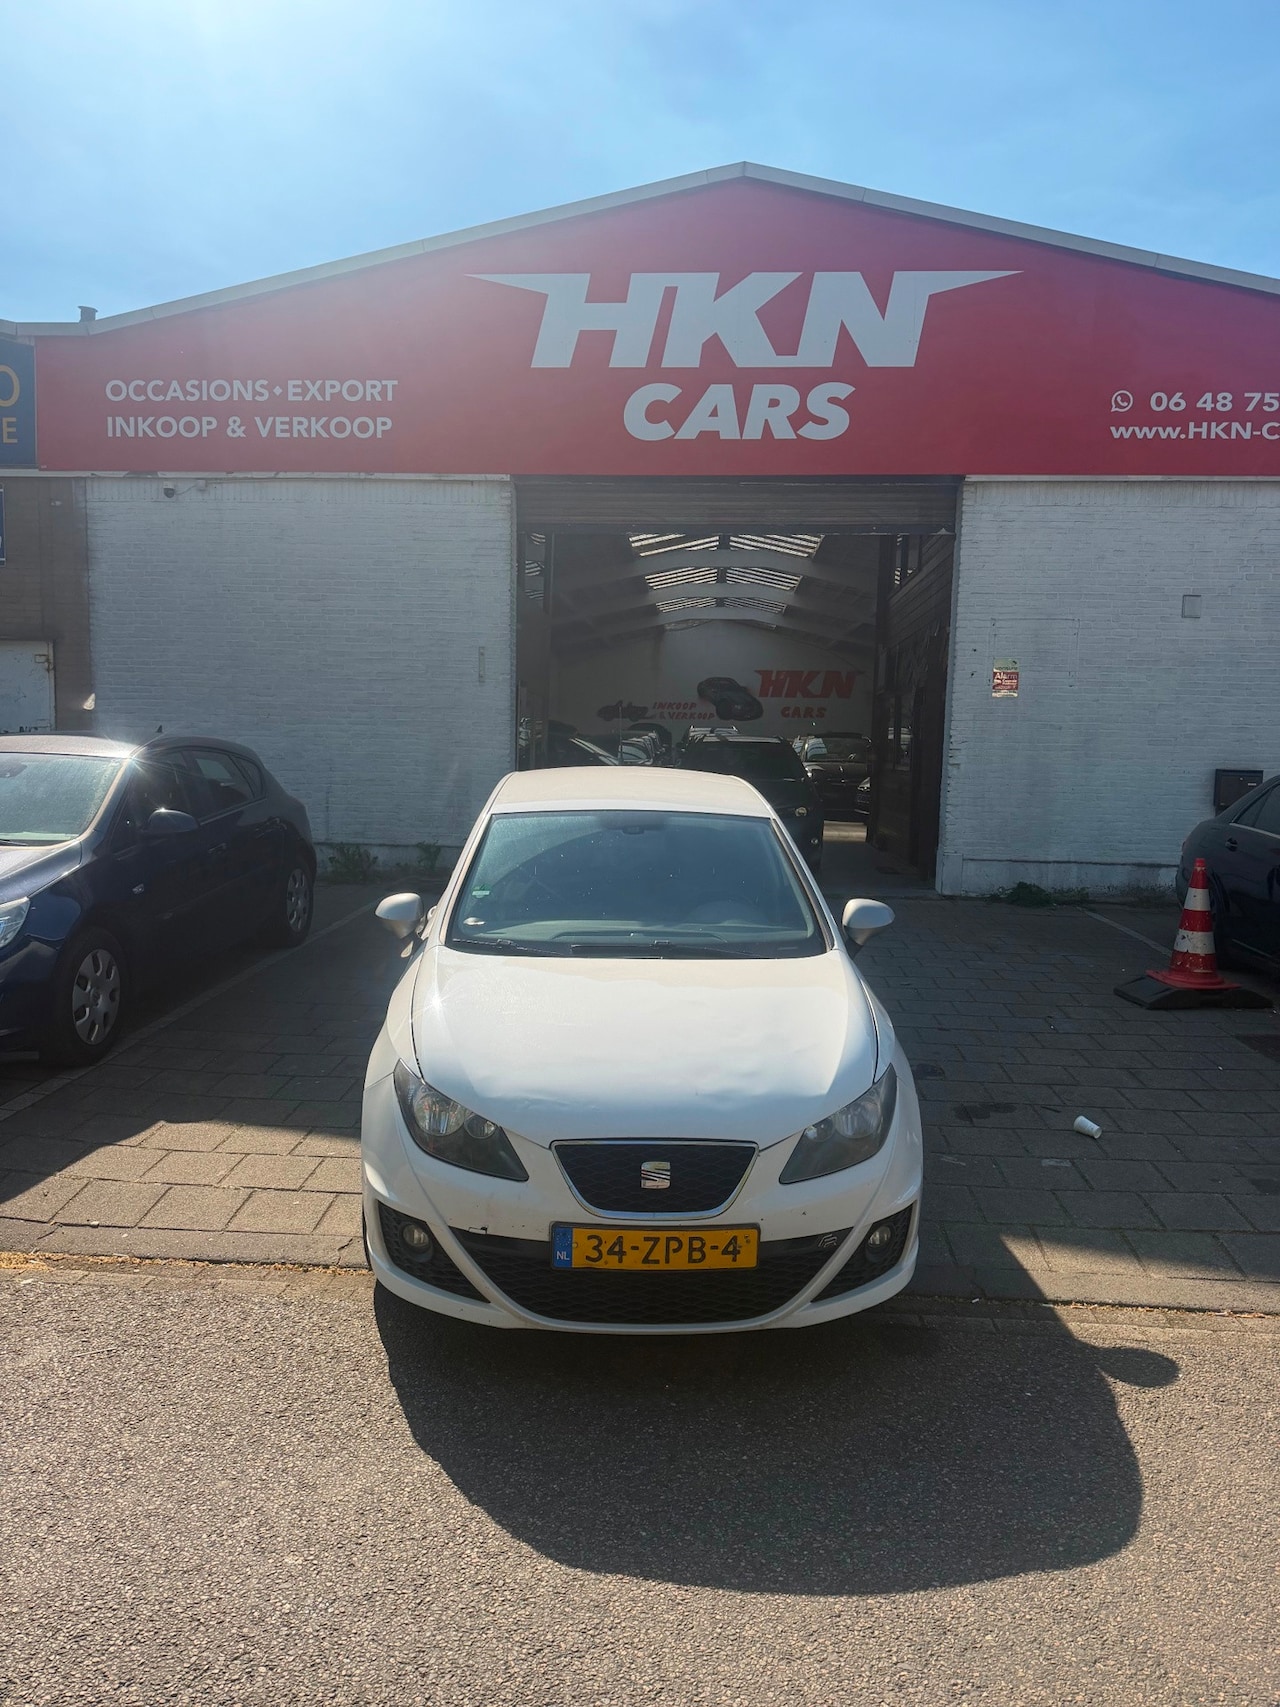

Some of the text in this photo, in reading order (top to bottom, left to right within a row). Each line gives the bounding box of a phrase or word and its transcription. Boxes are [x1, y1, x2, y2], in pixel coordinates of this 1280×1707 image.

[464, 270, 1024, 369] HKN
[105, 378, 399, 403] OCCASIONS EXPORT
[1149, 391, 1280, 412] 06 48 75
[623, 381, 857, 442] CARS
[106, 416, 393, 440] INKOOP & VERKOOP
[1110, 421, 1280, 440] www.HKN-C
[754, 669, 864, 699] HKN
[652, 701, 697, 711] INKOOP
[669, 710, 717, 721] VERKOOP
[780, 706, 827, 719] CARS
[556, 1250, 570, 1261] NL
[585, 1234, 741, 1265] 34-ZPB-4
